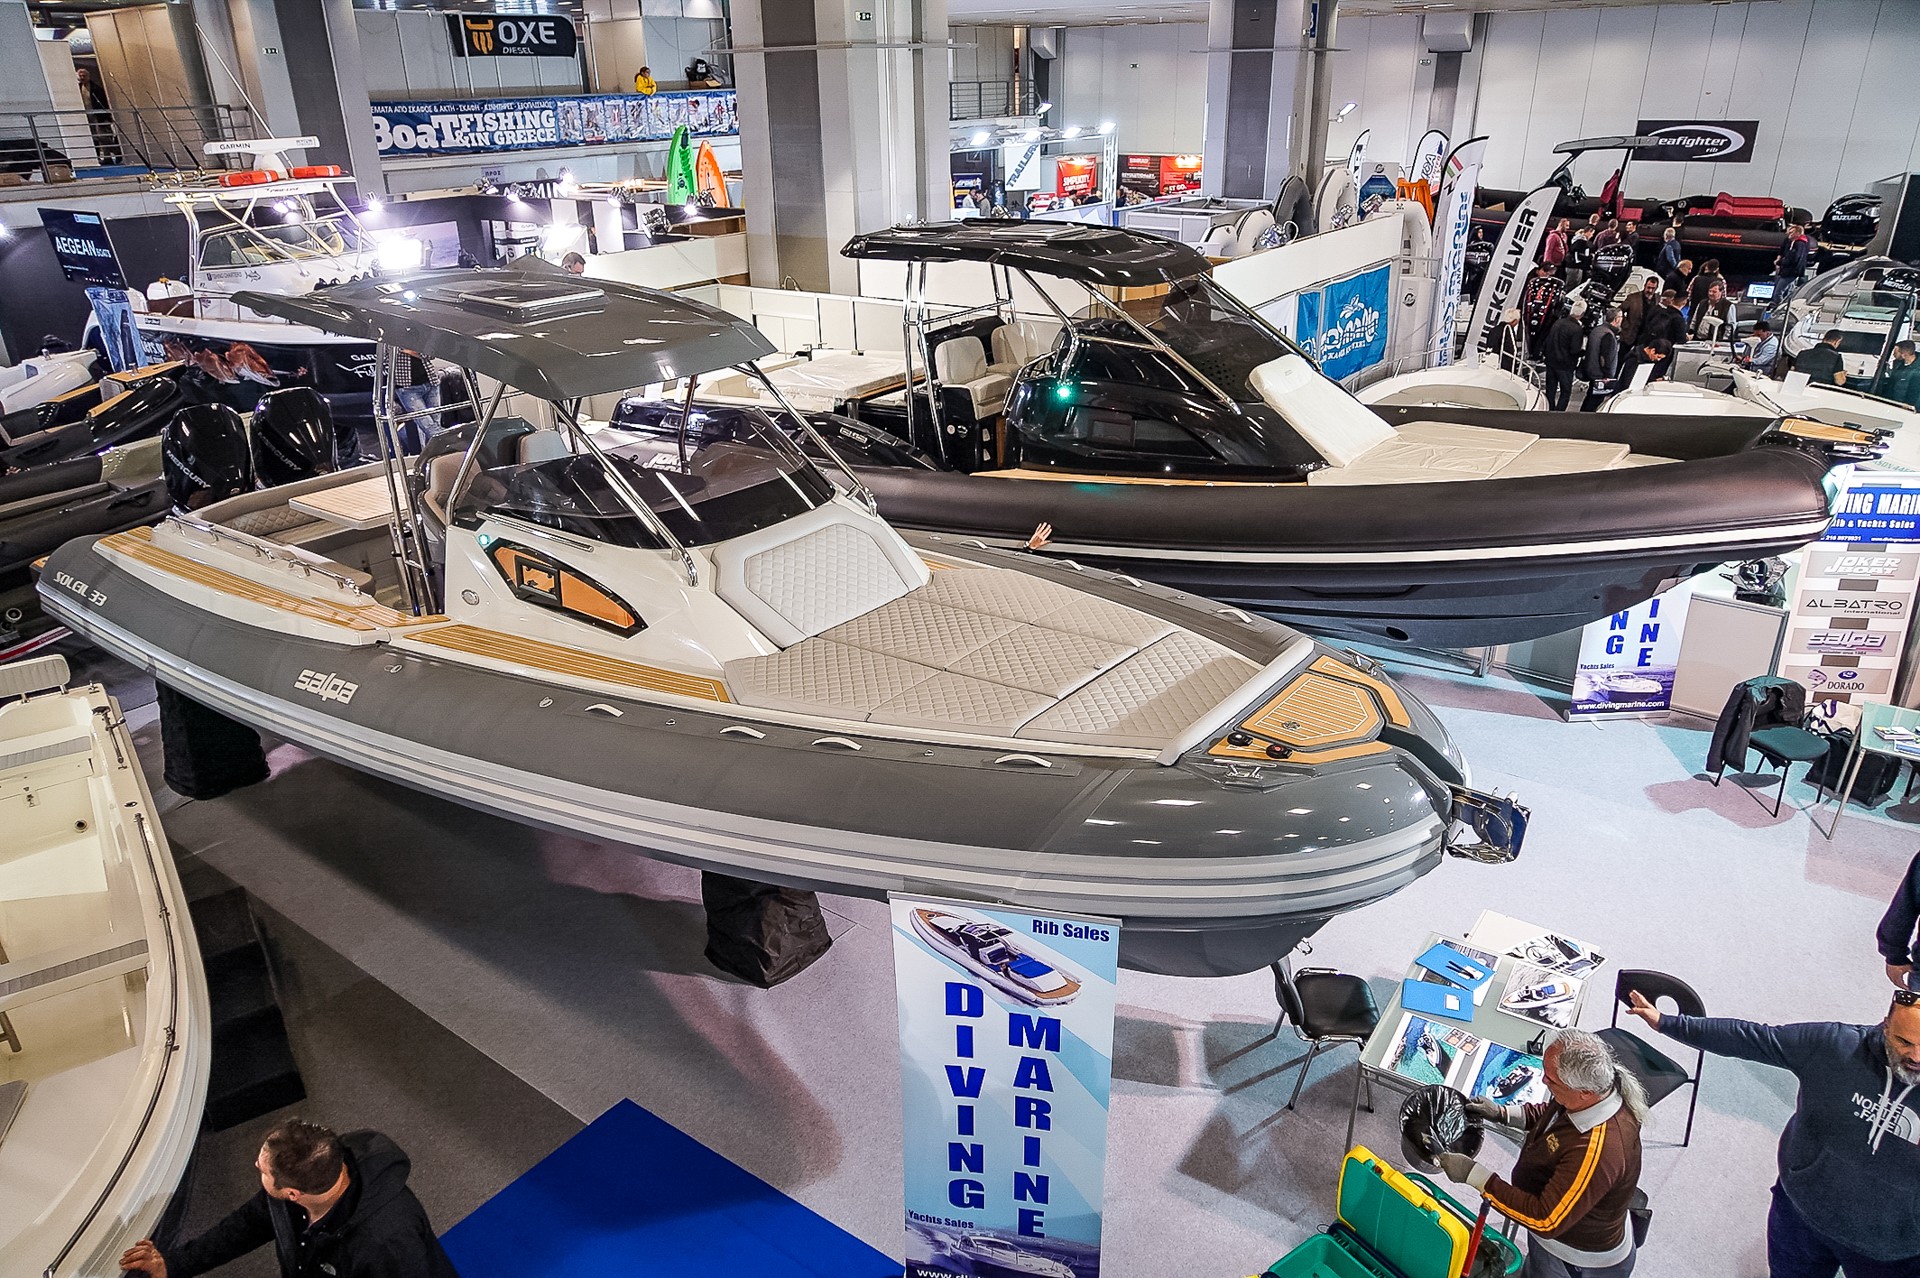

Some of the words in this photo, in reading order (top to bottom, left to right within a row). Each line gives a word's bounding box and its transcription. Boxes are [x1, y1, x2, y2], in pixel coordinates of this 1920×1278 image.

[498, 21, 557, 44] OXE
[502, 46, 534, 54] DIESEL
[371, 105, 393, 114] ΕΜΑΤΑ
[457, 110, 556, 132] FISHING
[494, 128, 556, 145] GREECE
[1658, 136, 1728, 148] eafighter
[55, 236, 97, 257] AEGEAN
[1477, 206, 1539, 354] UICKSILVER
[257, 431, 302, 471] MERCURY
[166, 450, 211, 489] MERCURY
[1824, 556, 1902, 574] JOKER
[1838, 566, 1898, 574] BOAT
[53, 571, 89, 597] SOLEIL
[88, 589, 108, 607] 33
[1806, 598, 1903, 611] ALBATRO
[1637, 598, 1661, 667] INE
[1807, 631, 1887, 648] salpa
[294, 669, 359, 704] salpa
[1827, 681, 1865, 691] DORADO
[1576, 701, 1665, 710] www.divingmarine.com
[1032, 919, 1059, 938] Rib
[1062, 922, 1110, 943] Sales
[944, 981, 987, 1210] DIVING
[1008, 1012, 1062, 1239] MARINE
[908, 1209, 942, 1225] Yachts
[944, 1217, 974, 1229] Sales
